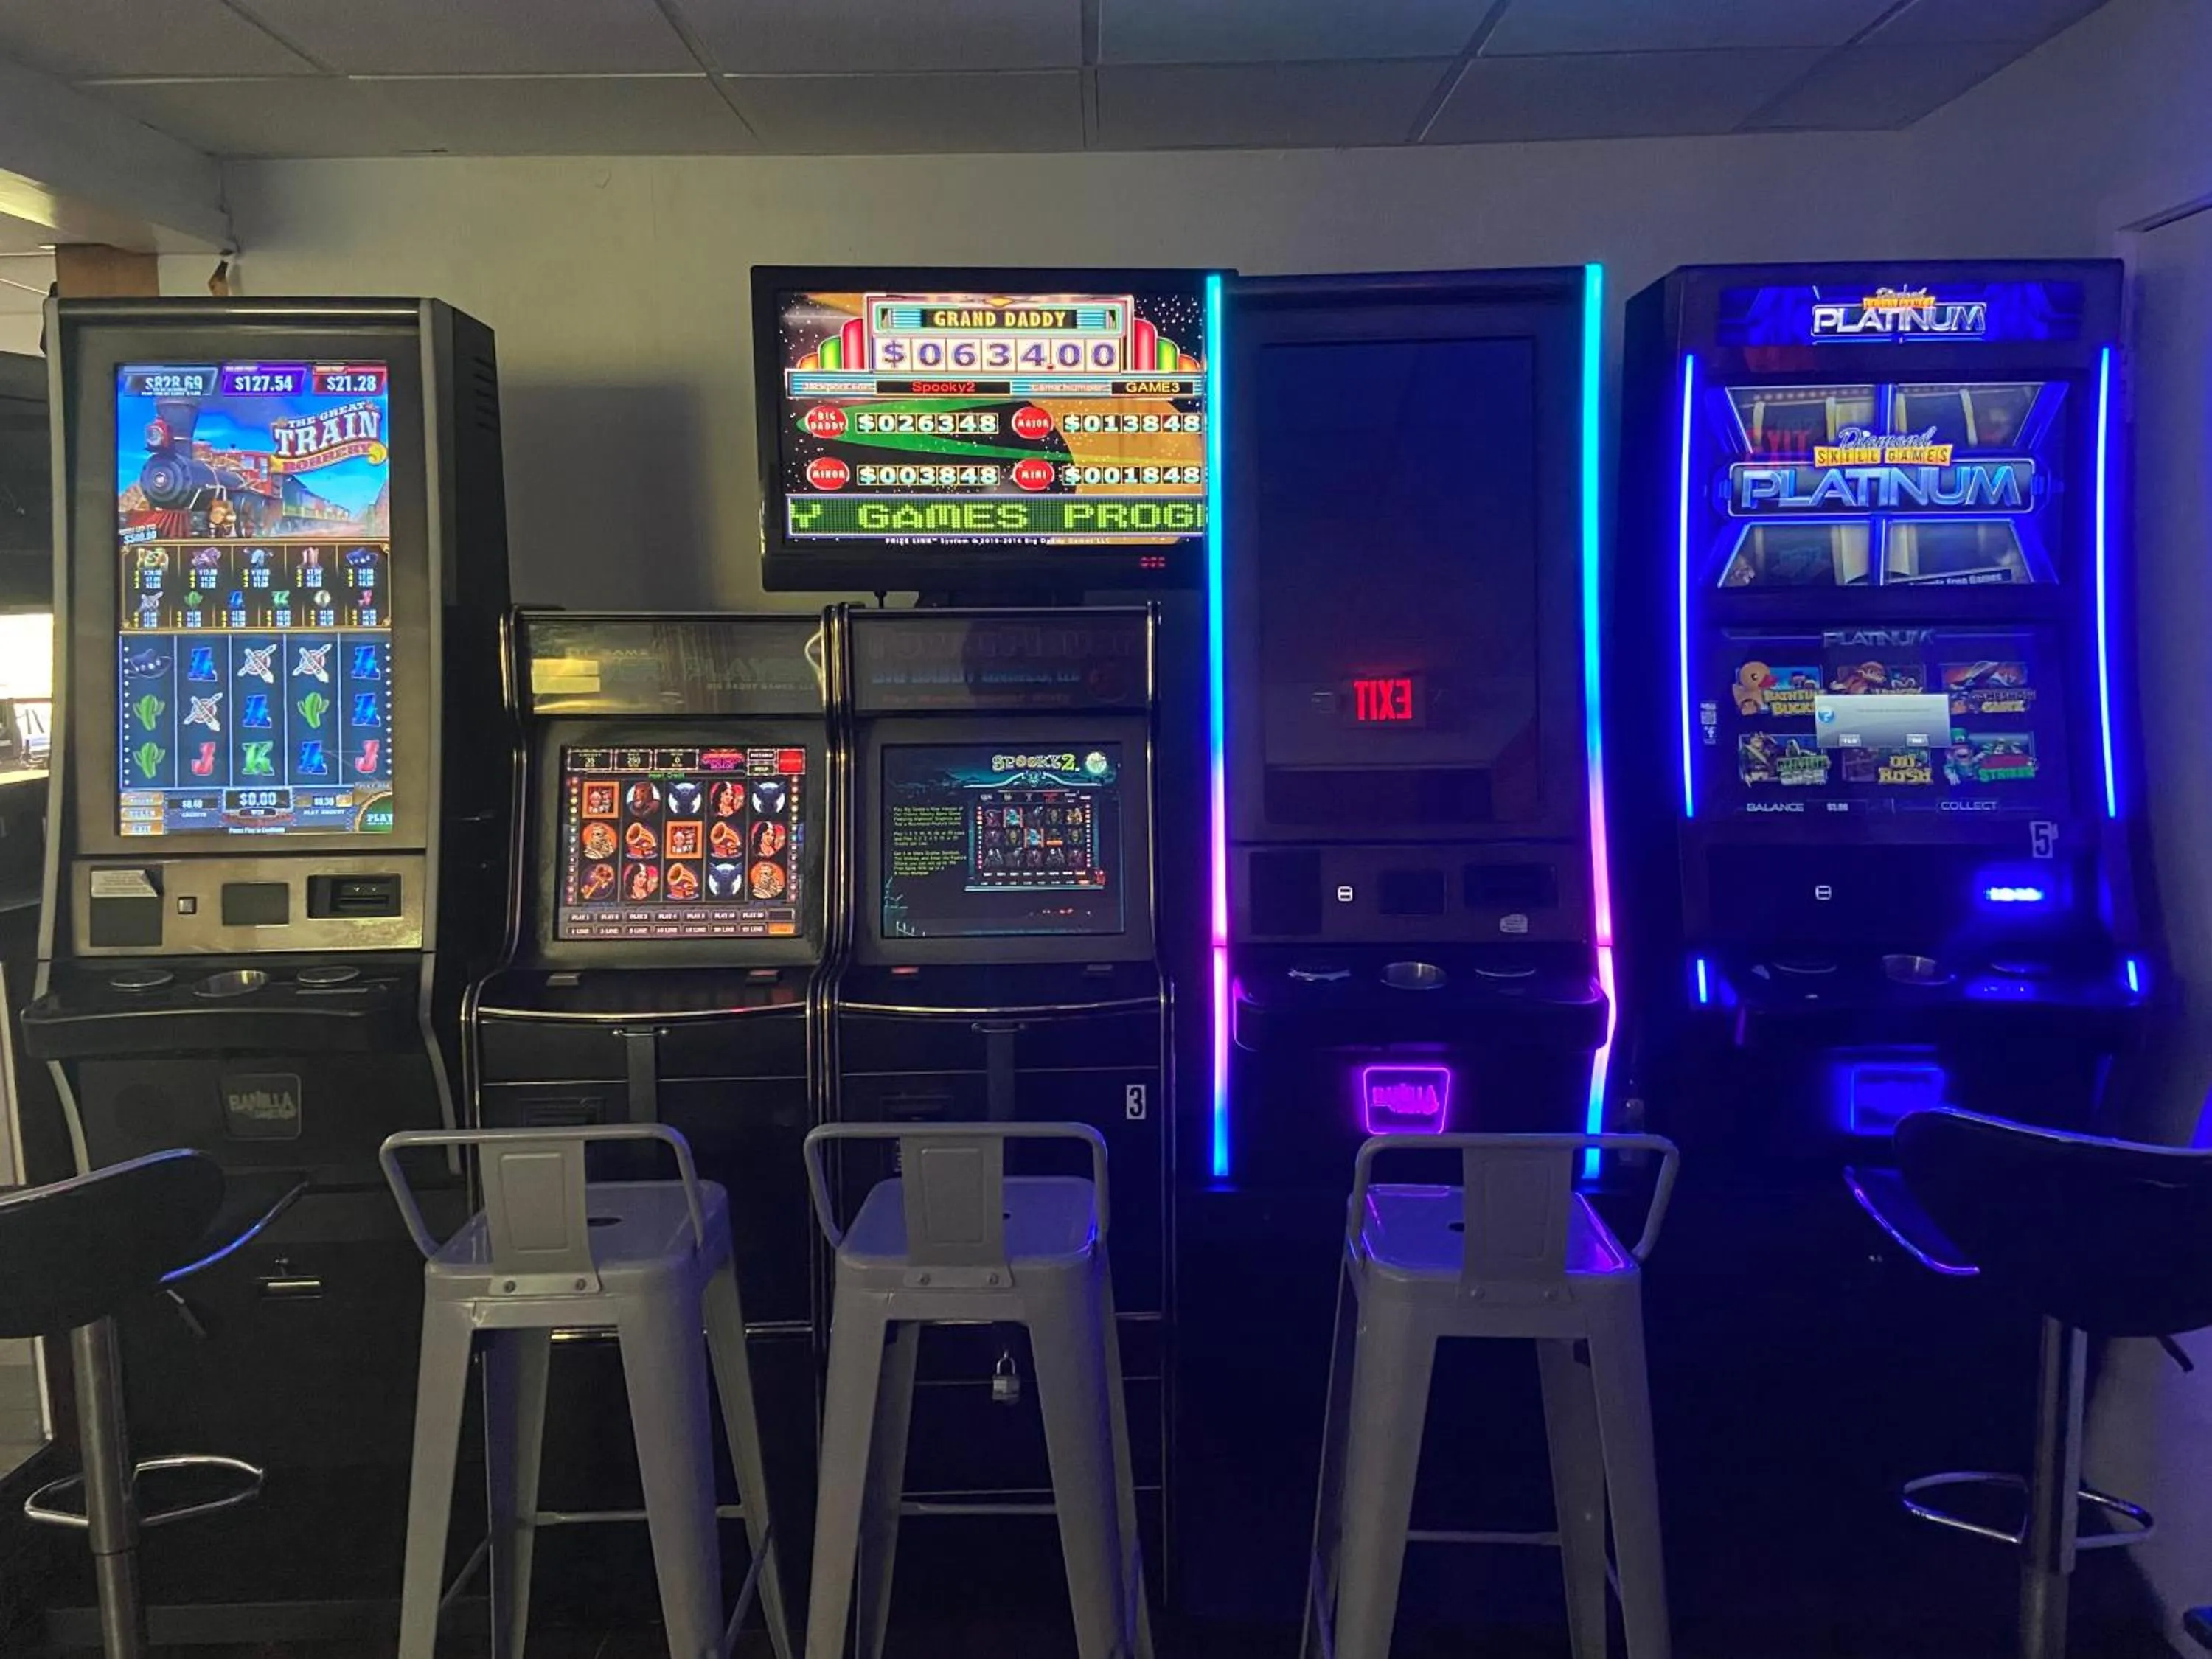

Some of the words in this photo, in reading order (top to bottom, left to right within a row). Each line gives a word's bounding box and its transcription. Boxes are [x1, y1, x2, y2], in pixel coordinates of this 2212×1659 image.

[933, 310, 997, 327] GRAND
[1004, 310, 1066, 327] DADDY
[1814, 306, 1985, 333] PLATINUM
[235, 375, 293, 392] $127.54
[327, 375, 377, 392] $21.28
[912, 381, 975, 394] Spooky2
[1126, 382, 1180, 394] GAME3
[288, 415, 316, 428] THE
[319, 400, 366, 421] GREAT
[818, 411, 835, 420] BIG
[1017, 417, 1050, 428] MAJOR
[810, 422, 845, 431] DADDY
[858, 414, 998, 433] $026348
[1064, 412, 1200, 434] $013848
[274, 411, 379, 456] TRAIN
[1838, 425, 1938, 450] Diamond
[1817, 449, 1879, 465] SKILL
[1888, 448, 1950, 464] GAMES
[813, 469, 844, 479] MINOR
[858, 466, 998, 485] $003848
[1020, 470, 1046, 479] MINI
[1064, 465, 1200, 485] $001848
[1740, 465, 2023, 509] PLATINUM
[858, 504, 1030, 529] GAMES
[1063, 504, 1207, 529] PROG
[1823, 631, 1936, 648] PLATINUM
[1763, 689, 1826, 702] BATHTU
[1771, 702, 1816, 716] BUCK
[191, 741, 215, 776] J
[241, 740, 274, 776] K
[355, 739, 379, 773] J
[1878, 767, 1933, 785] RUSH
[240, 792, 276, 806] $0.00
[1747, 802, 1804, 813] BALANCE
[1939, 800, 1997, 811] COLLECT
[367, 813, 393, 822] PLAY
[2034, 824, 2050, 855] 5
[1129, 1086, 1143, 1118] 3
